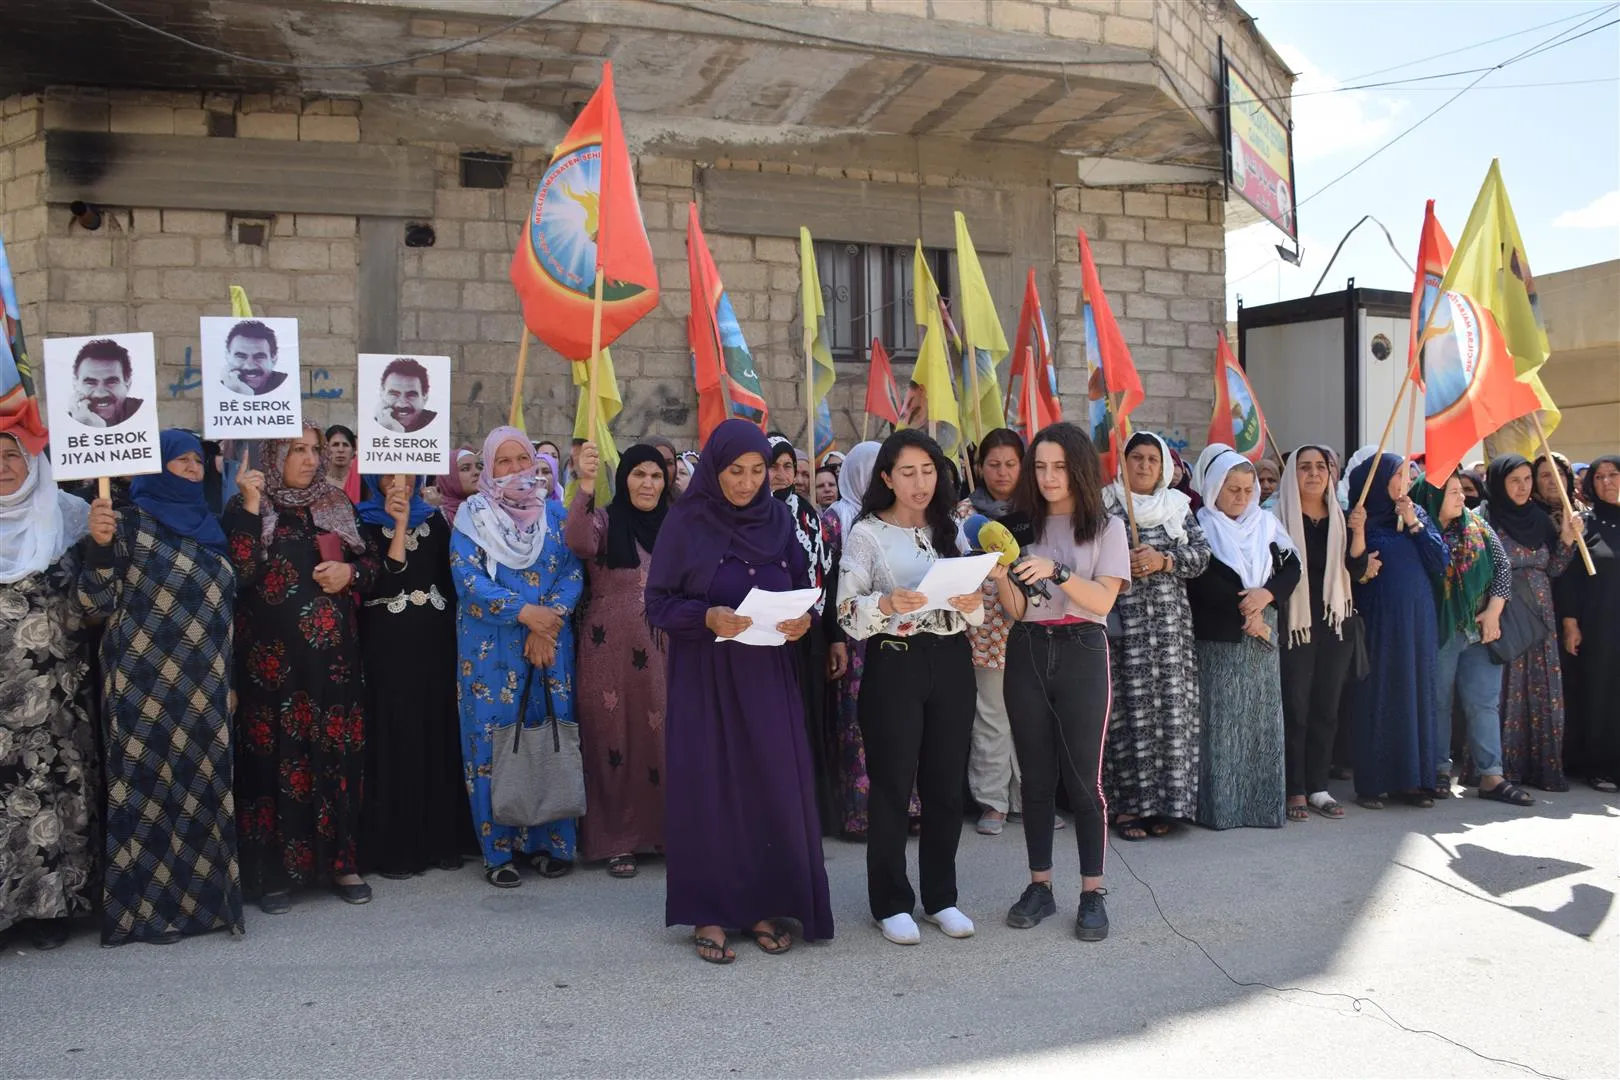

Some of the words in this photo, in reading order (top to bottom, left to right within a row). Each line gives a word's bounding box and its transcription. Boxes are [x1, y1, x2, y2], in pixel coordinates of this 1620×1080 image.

[220, 399, 239, 412] BÊ
[243, 400, 291, 412] SEROK
[213, 415, 253, 427] JIYAN
[257, 414, 295, 426] NABE
[68, 433, 90, 448] BÊ
[94, 430, 148, 446] SEROK
[372, 436, 391, 448] BÊ
[394, 438, 438, 449] SEROK
[61, 448, 105, 465] JIYAN
[110, 446, 153, 462] NABE
[366, 451, 402, 462] JIYAN
[406, 452, 441, 463] NABE
